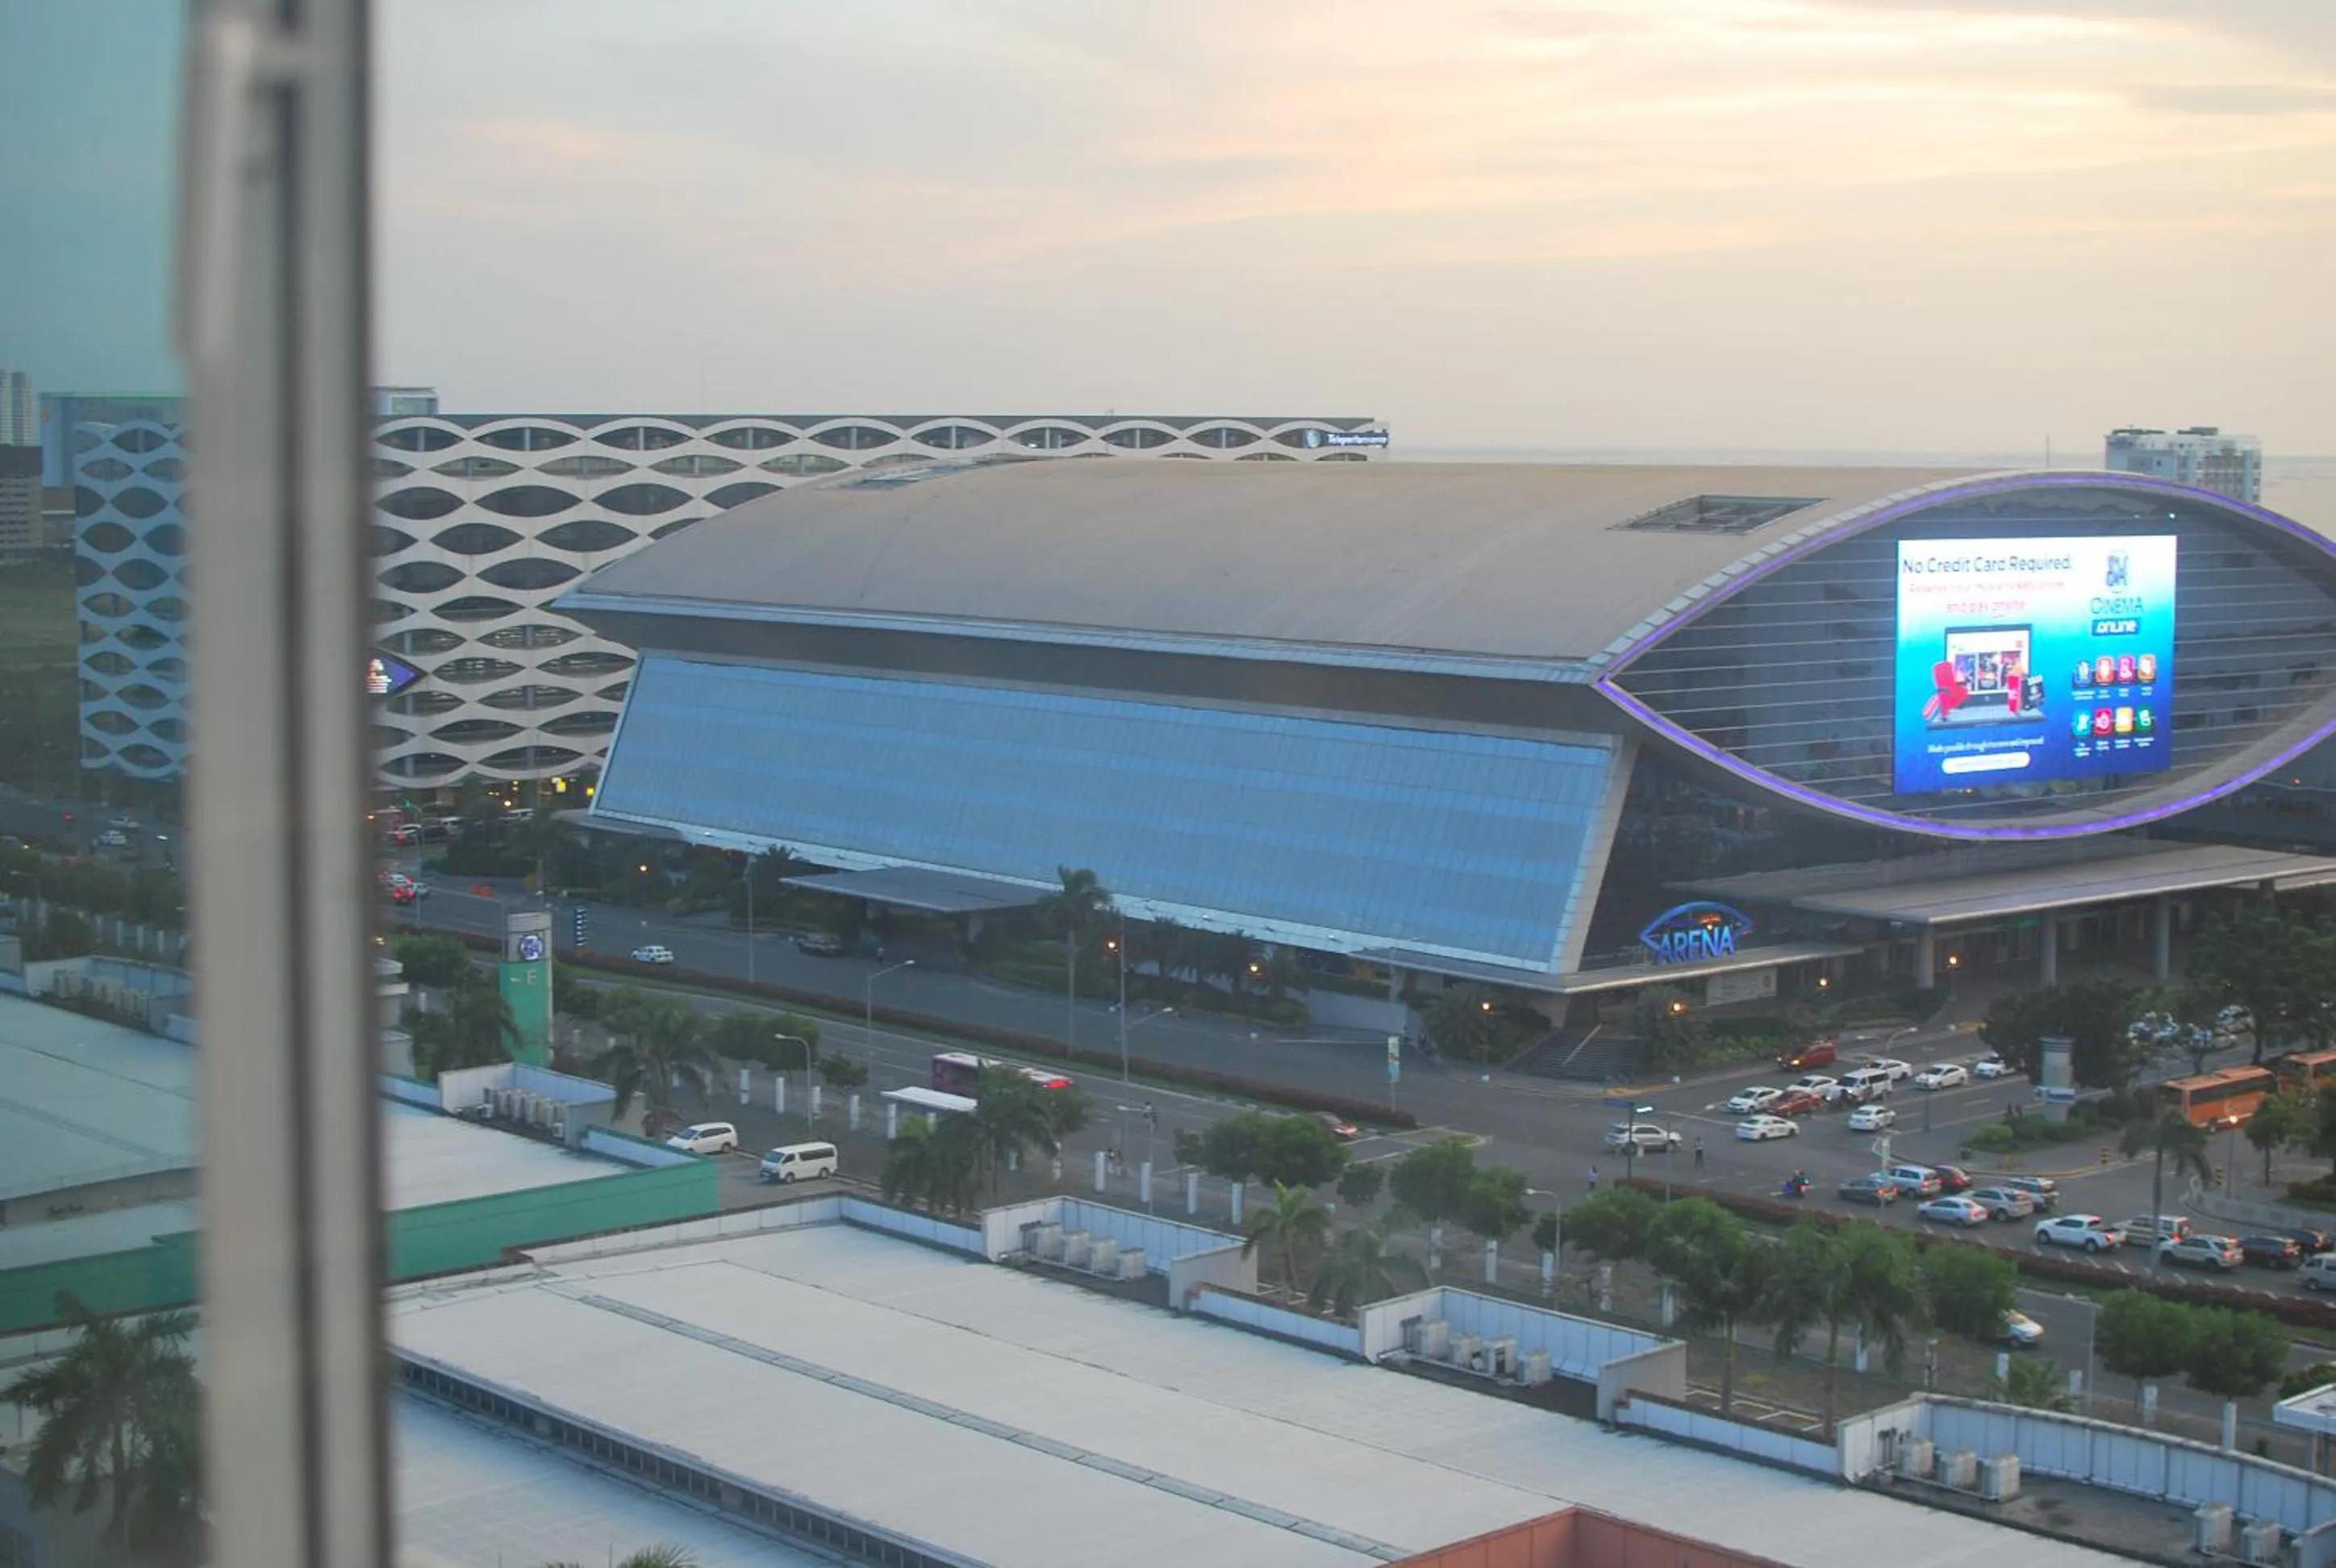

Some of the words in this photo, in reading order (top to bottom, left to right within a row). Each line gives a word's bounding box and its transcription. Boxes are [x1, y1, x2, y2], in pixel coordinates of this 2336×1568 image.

[1903, 558, 1923, 573] No
[1927, 557, 1970, 573] Credit
[1975, 556, 2006, 572] Card
[1656, 925, 1736, 961] ARENA
